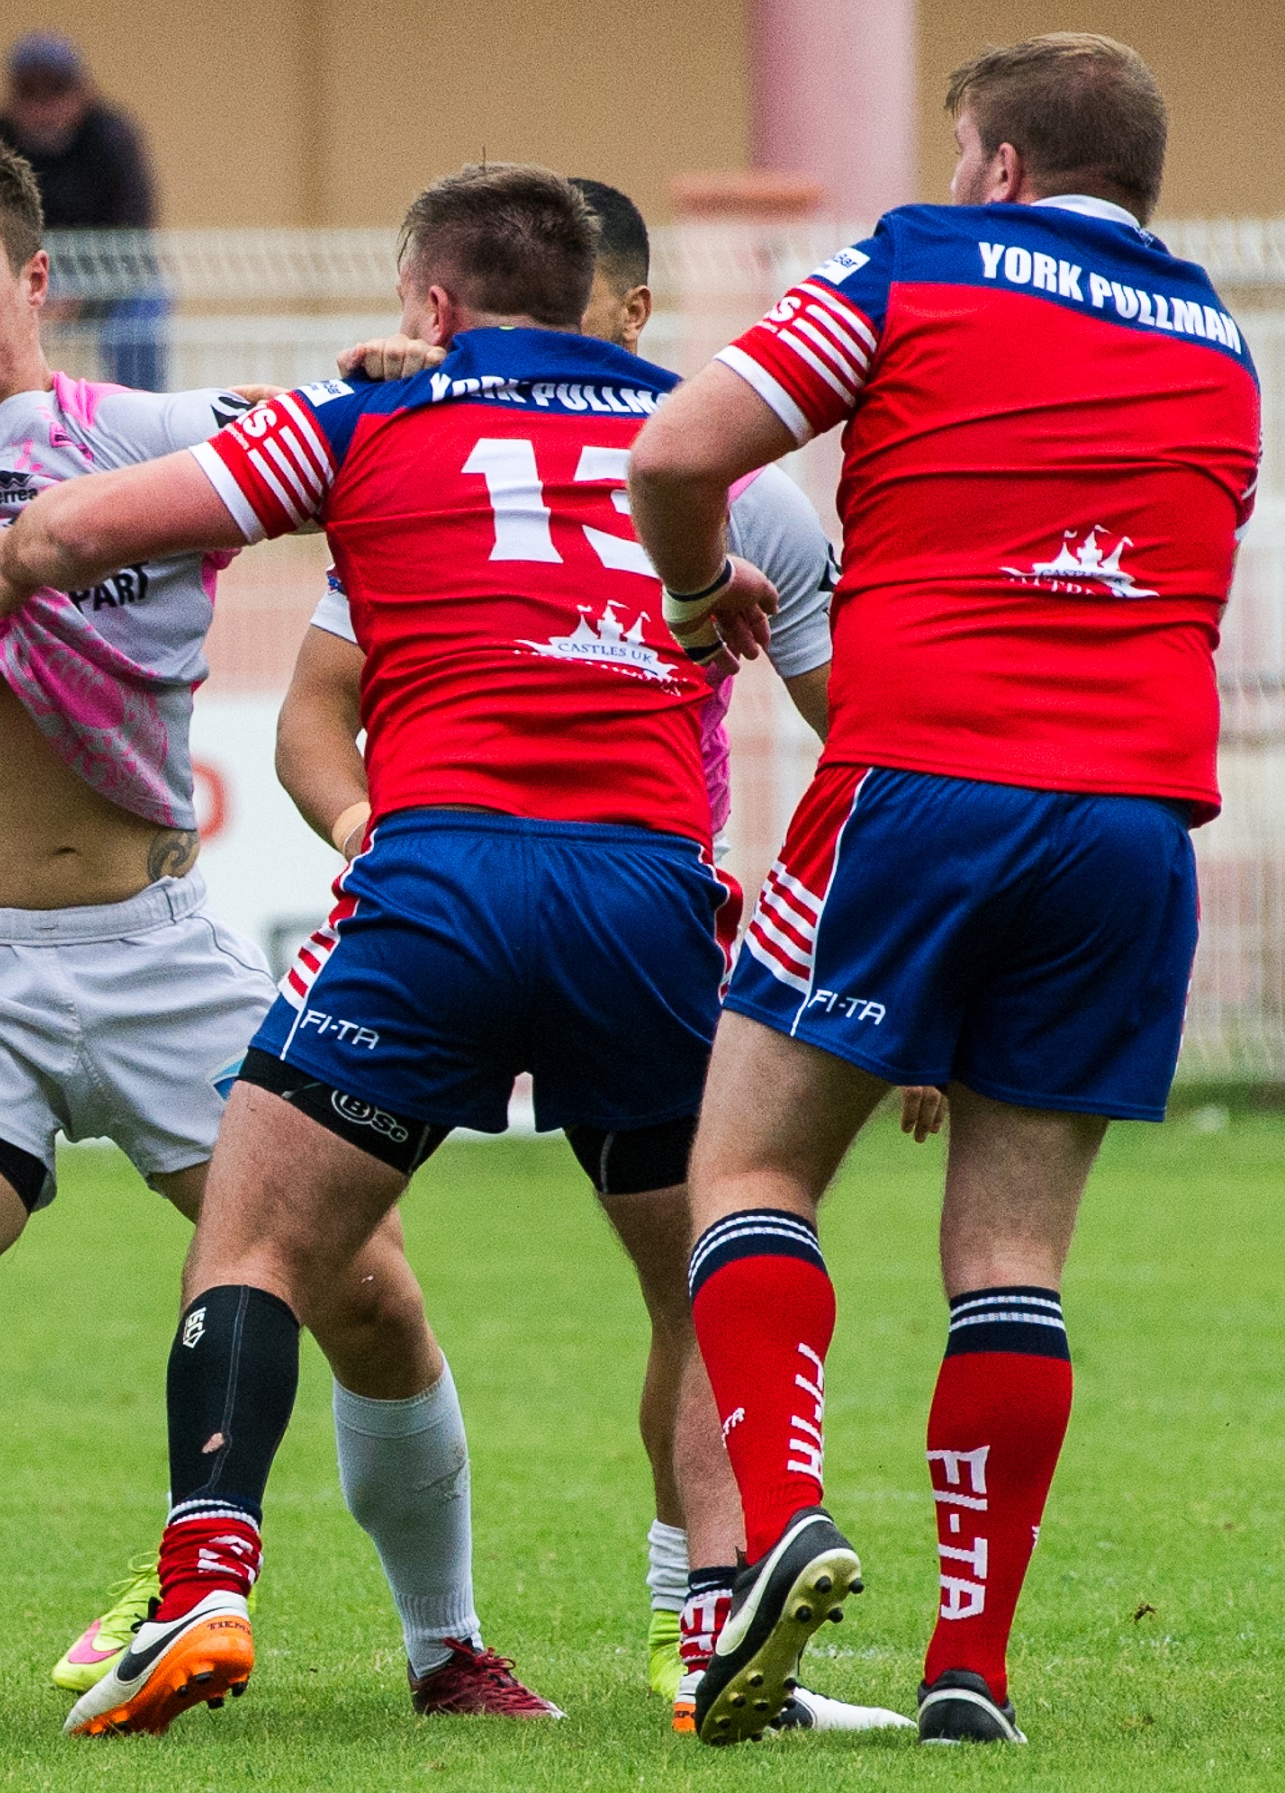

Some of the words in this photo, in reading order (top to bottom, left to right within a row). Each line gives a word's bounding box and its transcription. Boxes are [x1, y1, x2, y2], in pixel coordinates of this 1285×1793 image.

[978, 241, 1084, 303] YORK
[1089, 272, 1242, 355] PULLMAN
[430, 372, 526, 403] YORK
[557, 642, 626, 657] CASTLES
[631, 650, 653, 664] UK
[808, 989, 886, 1025] FI-TA
[300, 1009, 380, 1050] FI-TA
[926, 1444, 991, 1621] FI-TA
